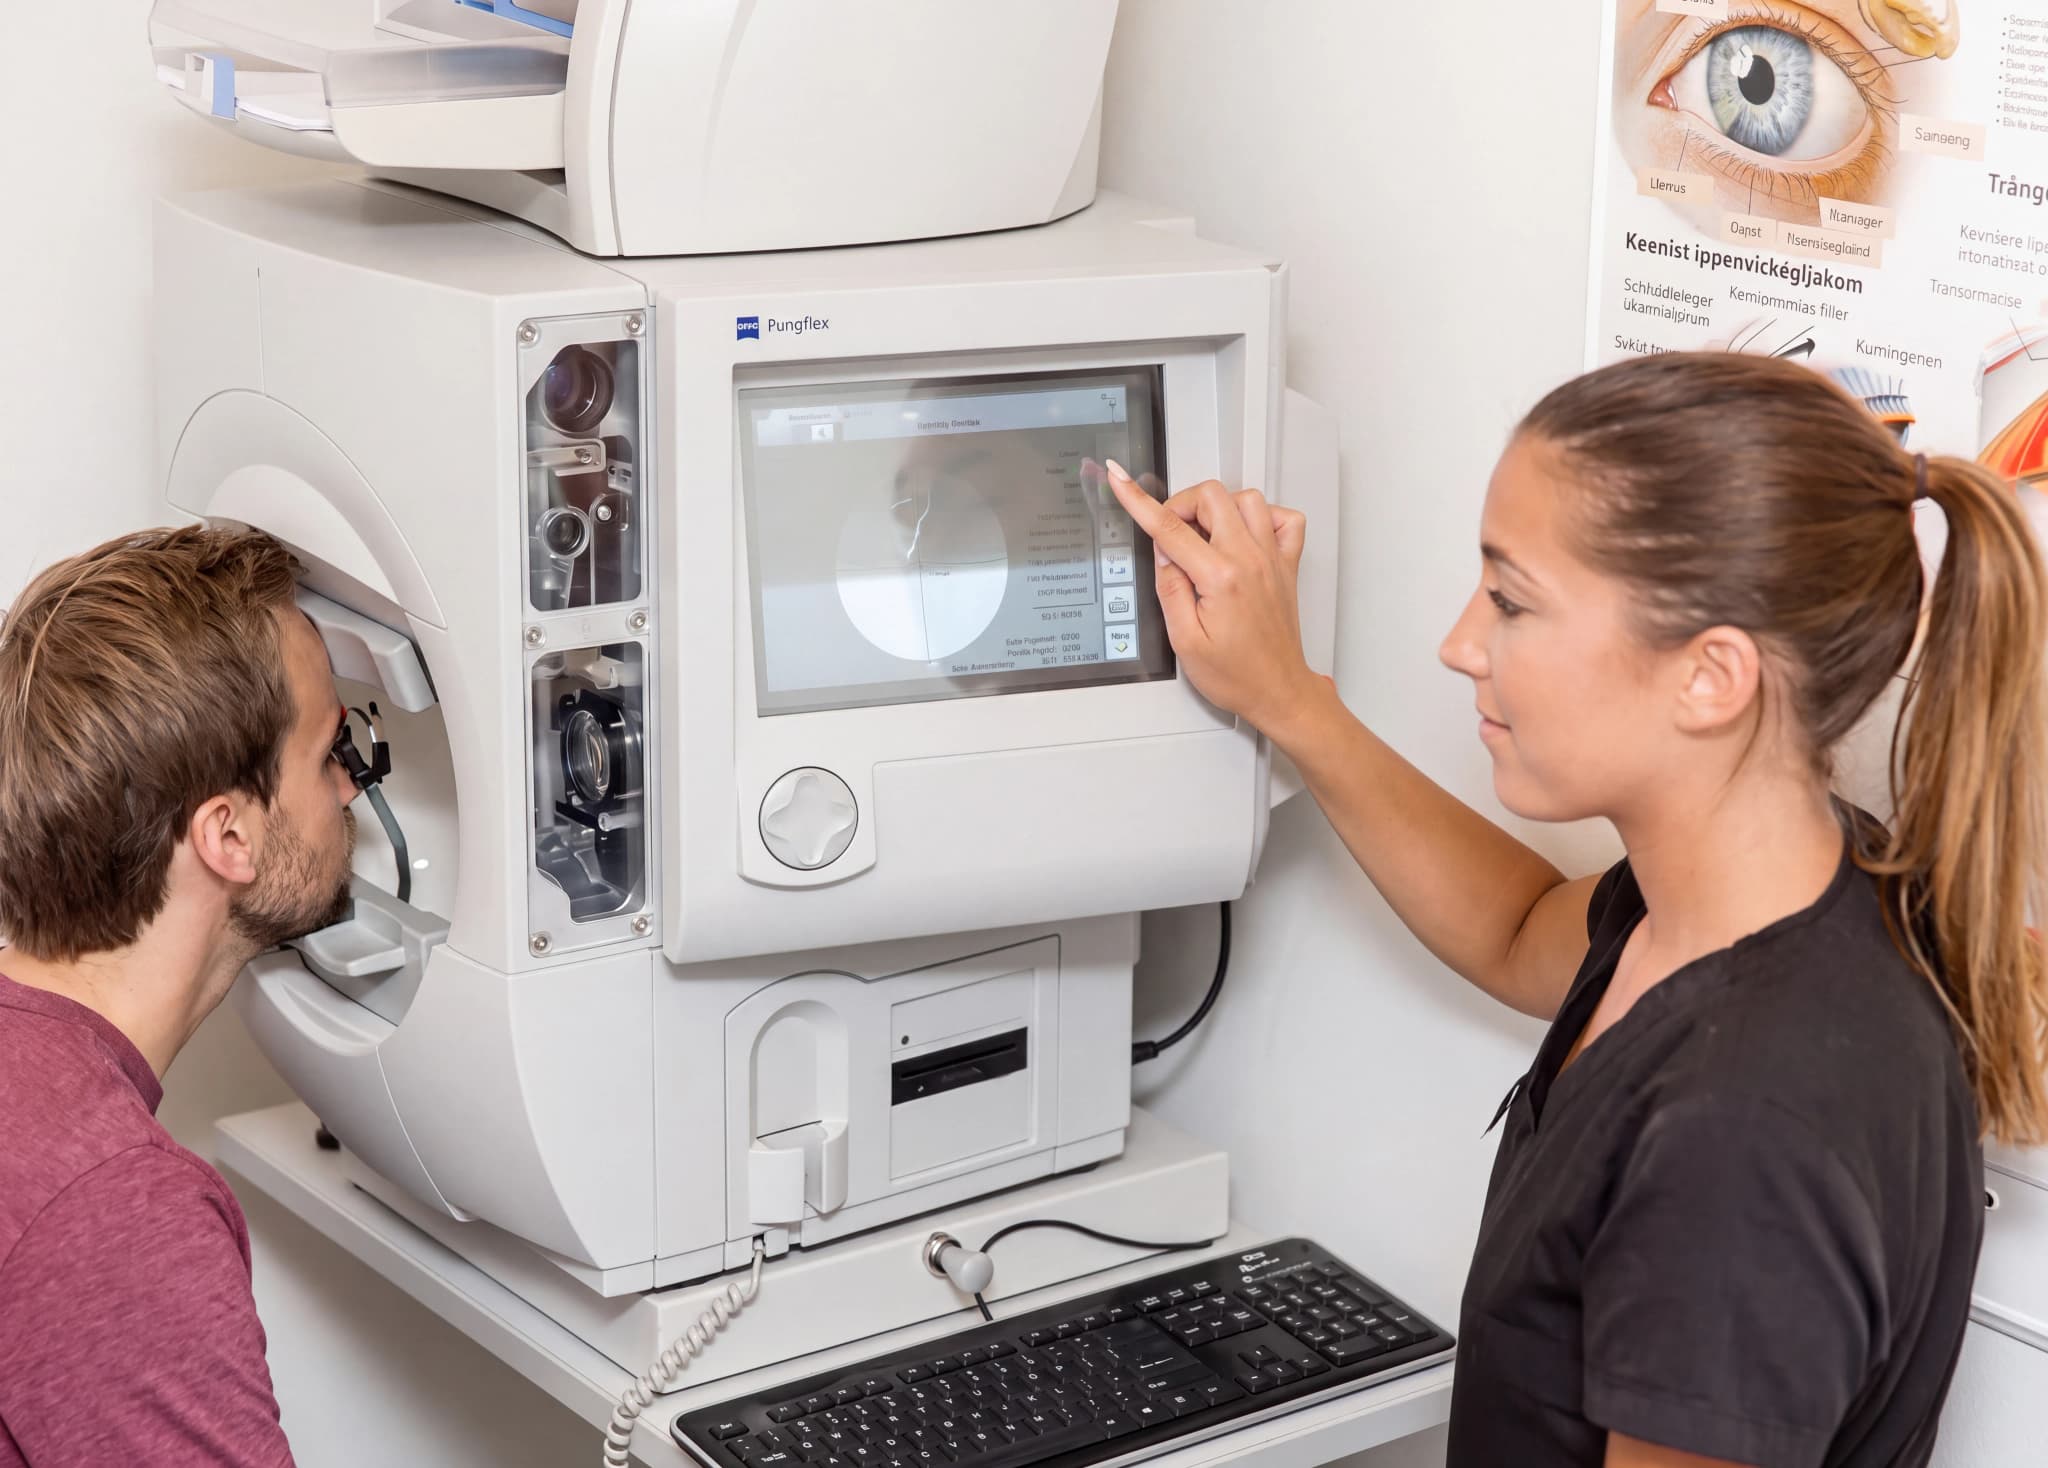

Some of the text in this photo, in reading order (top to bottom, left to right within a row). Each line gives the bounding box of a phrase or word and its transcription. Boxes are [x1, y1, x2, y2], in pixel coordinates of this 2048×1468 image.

[1988, 173, 2048, 206] Trång
[1625, 231, 1690, 260] Keenist
[768, 316, 830, 335] Pungflex
[1856, 338, 1942, 369] Kumingenen
